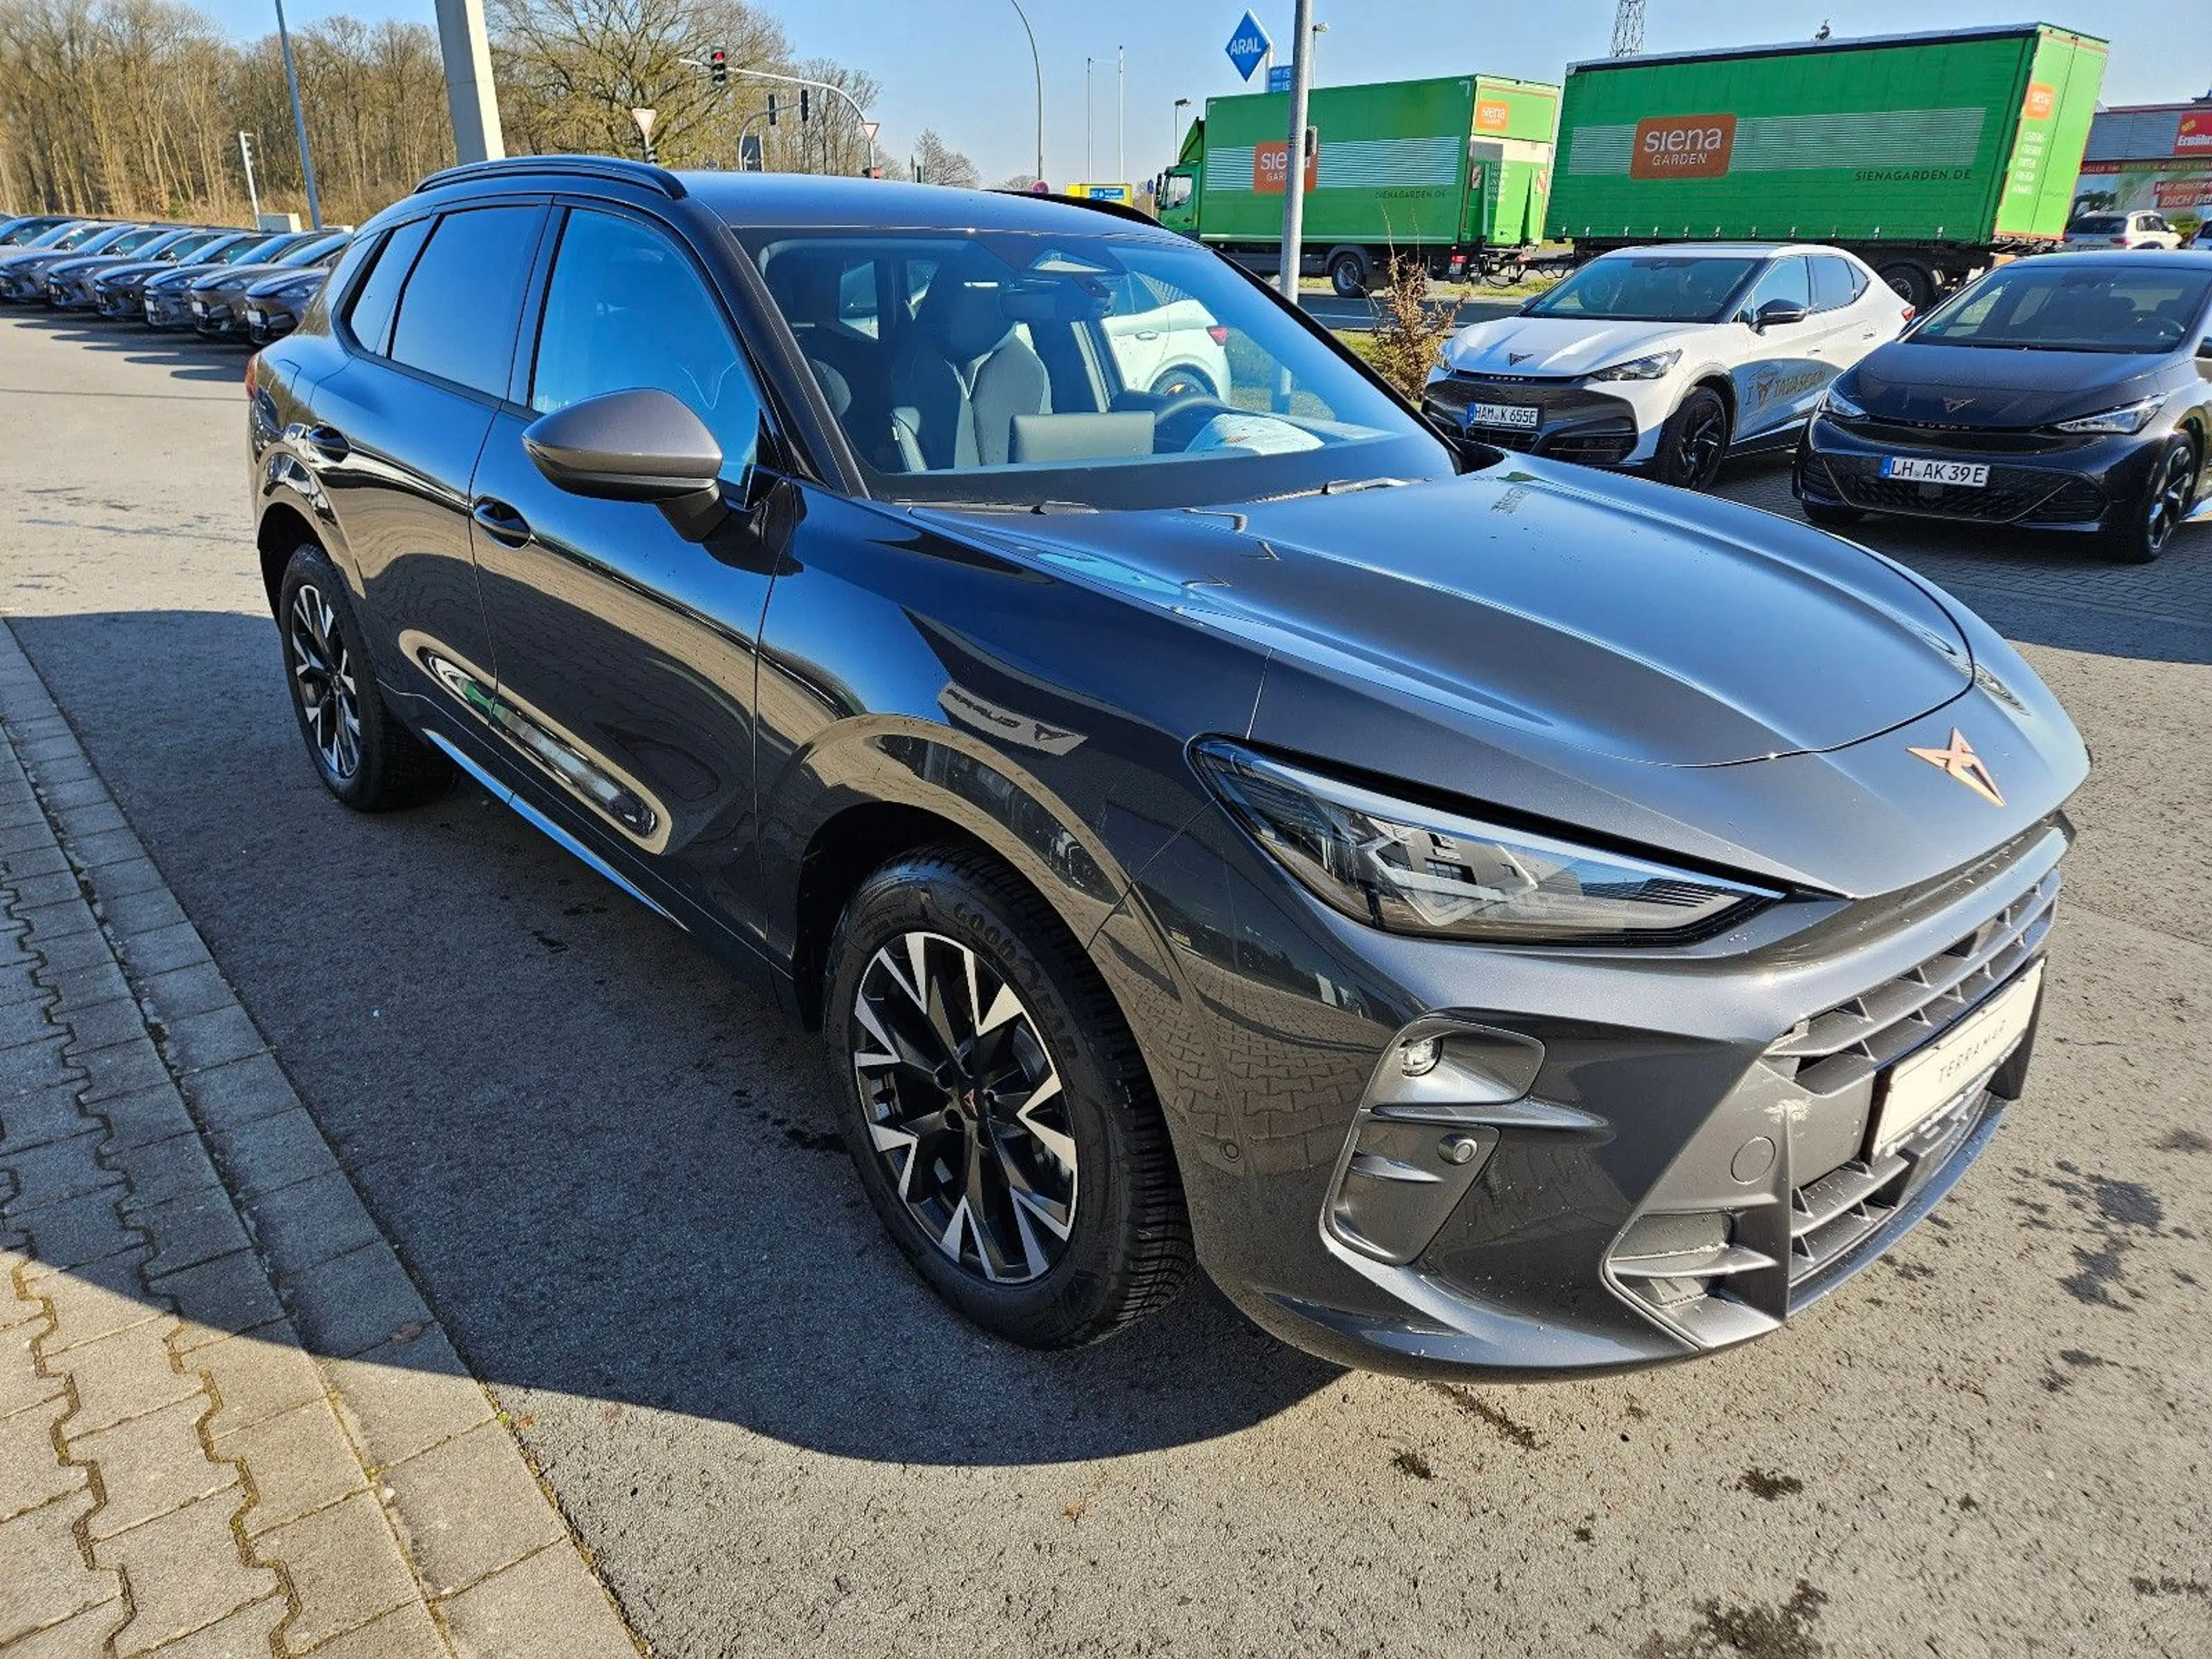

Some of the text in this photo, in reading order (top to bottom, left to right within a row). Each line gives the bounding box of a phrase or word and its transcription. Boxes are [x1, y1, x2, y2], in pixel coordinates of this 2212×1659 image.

[1230, 37, 1262, 56] ARAL
[1643, 128, 1722, 152] siena
[1652, 152, 1707, 166] GARDEN
[1855, 169, 1971, 181] SIENAGARDEN.DE
[1475, 406, 1536, 424] HAM K 655E
[1891, 460, 1914, 476] LH
[1923, 463, 1946, 480] AK
